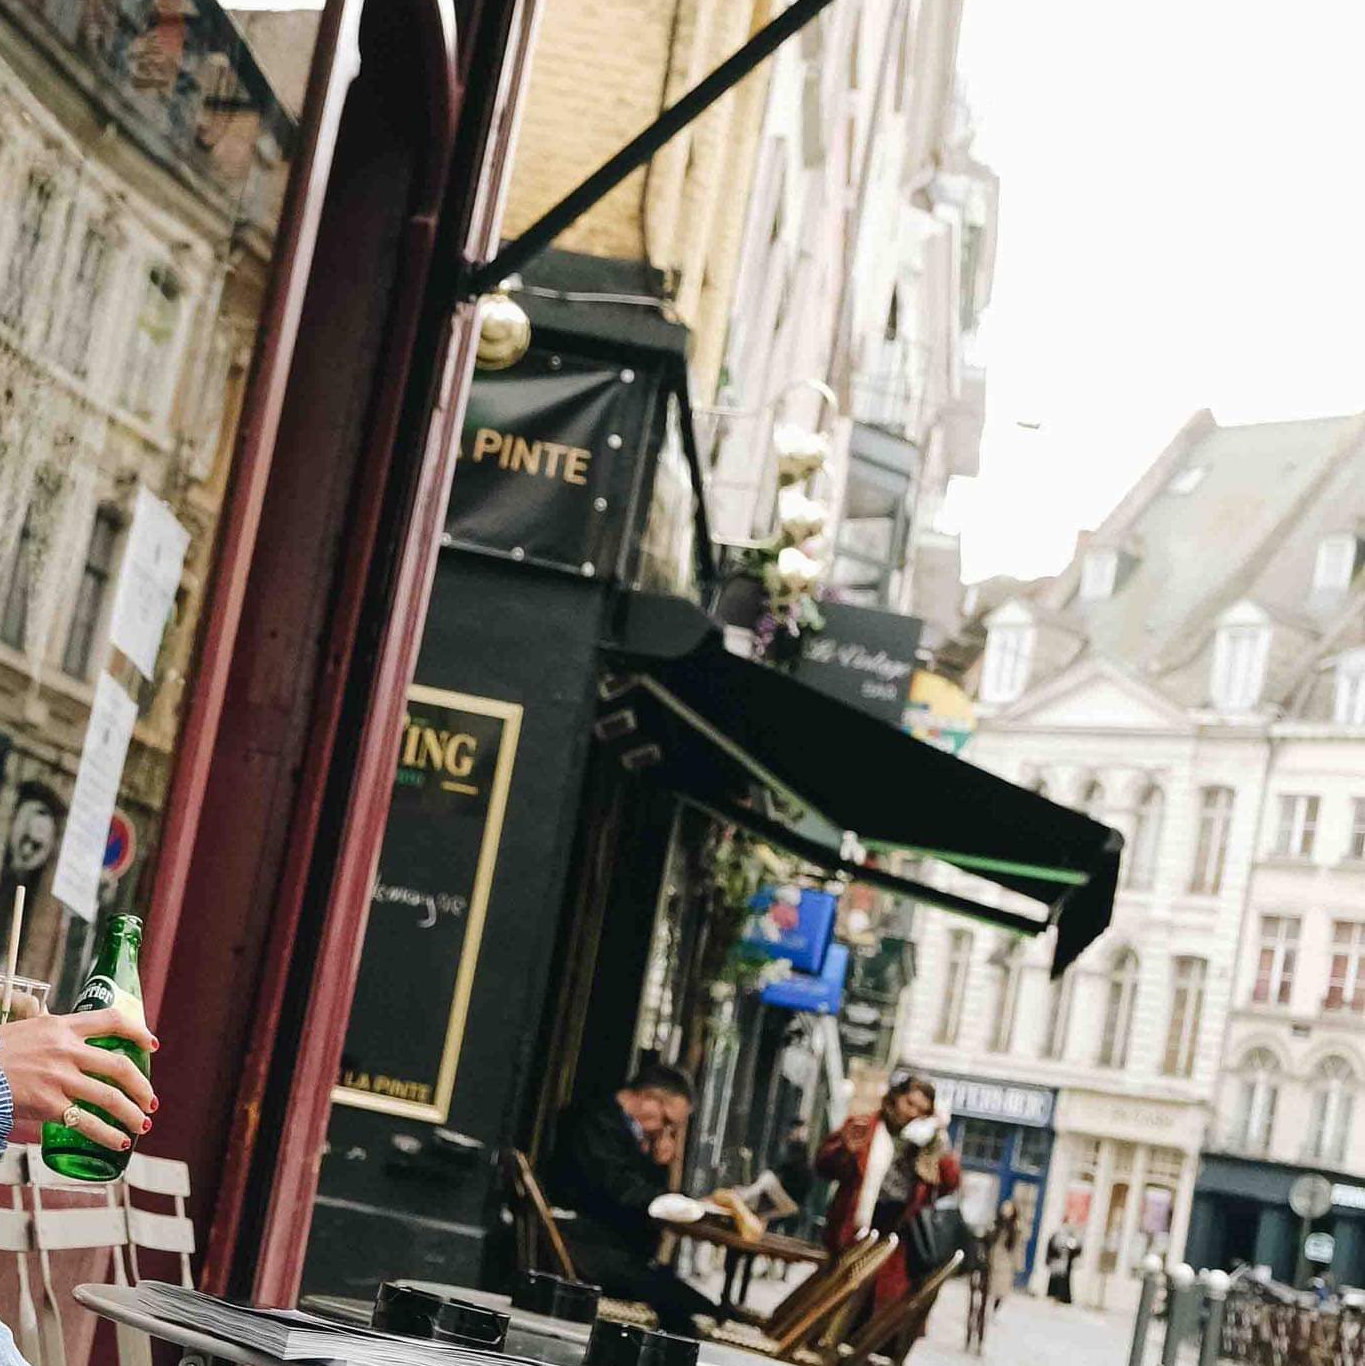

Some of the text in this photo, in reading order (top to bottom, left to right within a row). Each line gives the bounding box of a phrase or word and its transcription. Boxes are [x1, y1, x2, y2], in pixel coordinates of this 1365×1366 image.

[473, 427, 592, 485] PINTE
[402, 712, 478, 777] ING
[373, 1074, 434, 1104] PINTE
